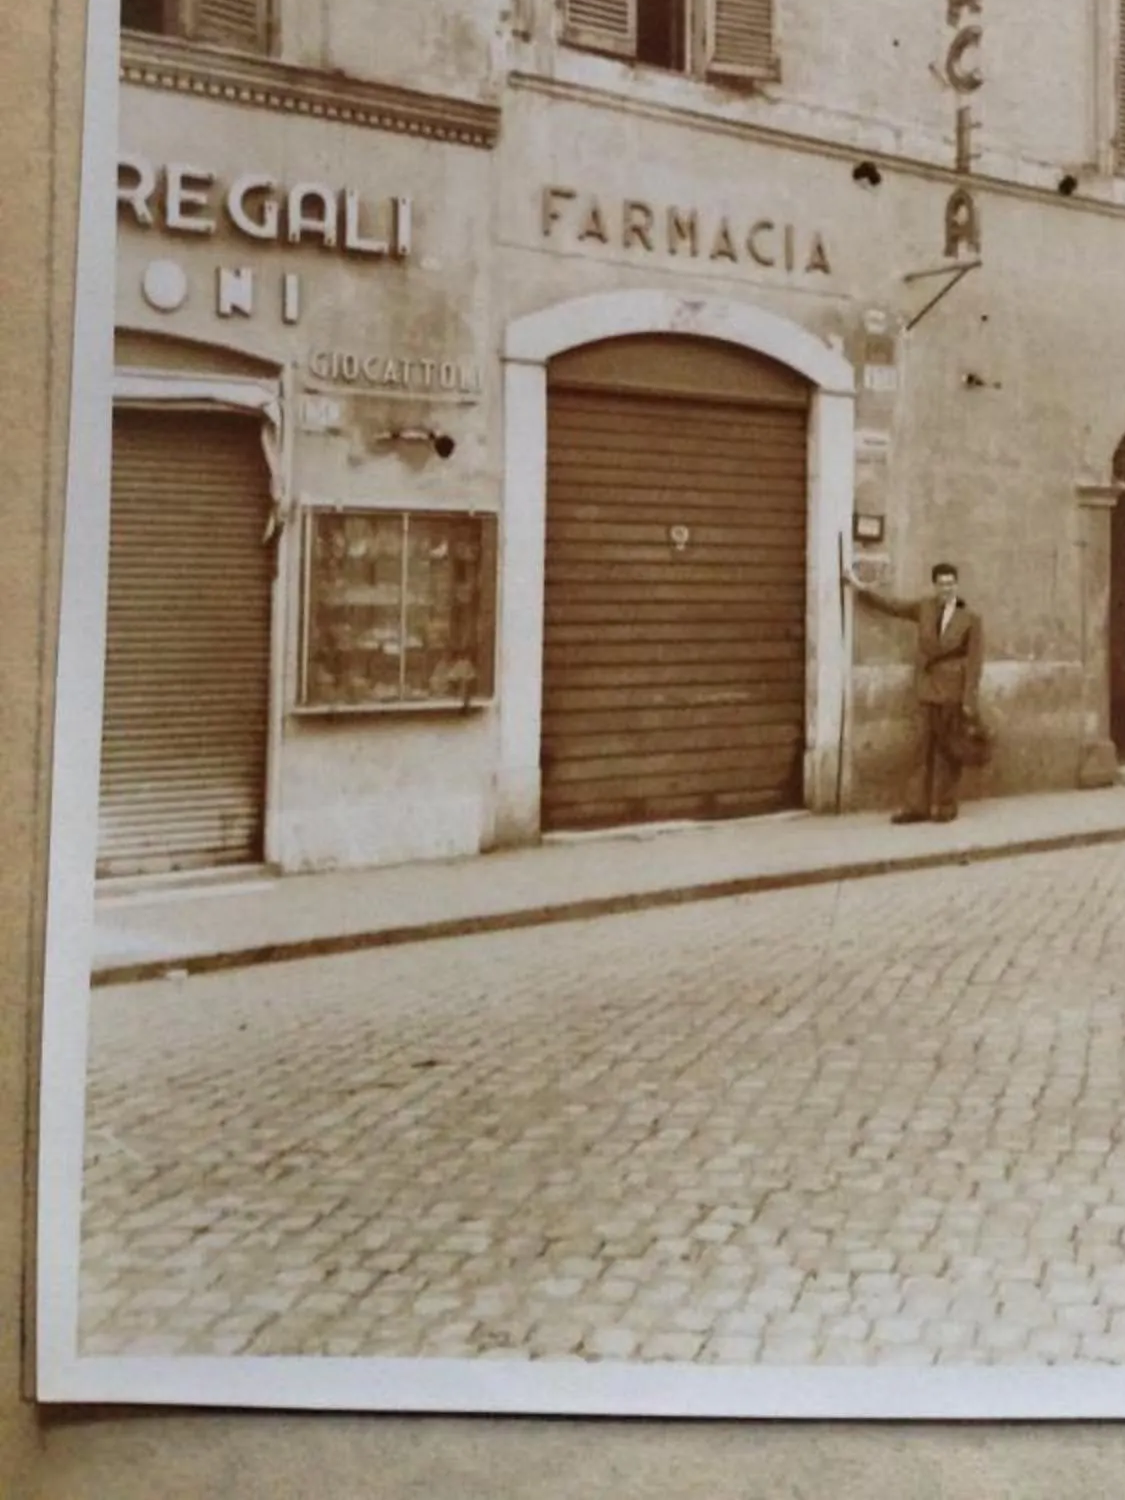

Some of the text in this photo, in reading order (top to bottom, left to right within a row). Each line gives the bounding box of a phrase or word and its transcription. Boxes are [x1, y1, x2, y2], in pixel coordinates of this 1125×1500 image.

[117, 157, 413, 259] REGALI
[540, 185, 833, 276] FARMACIA
[309, 351, 483, 393] GIOCATTOLI
